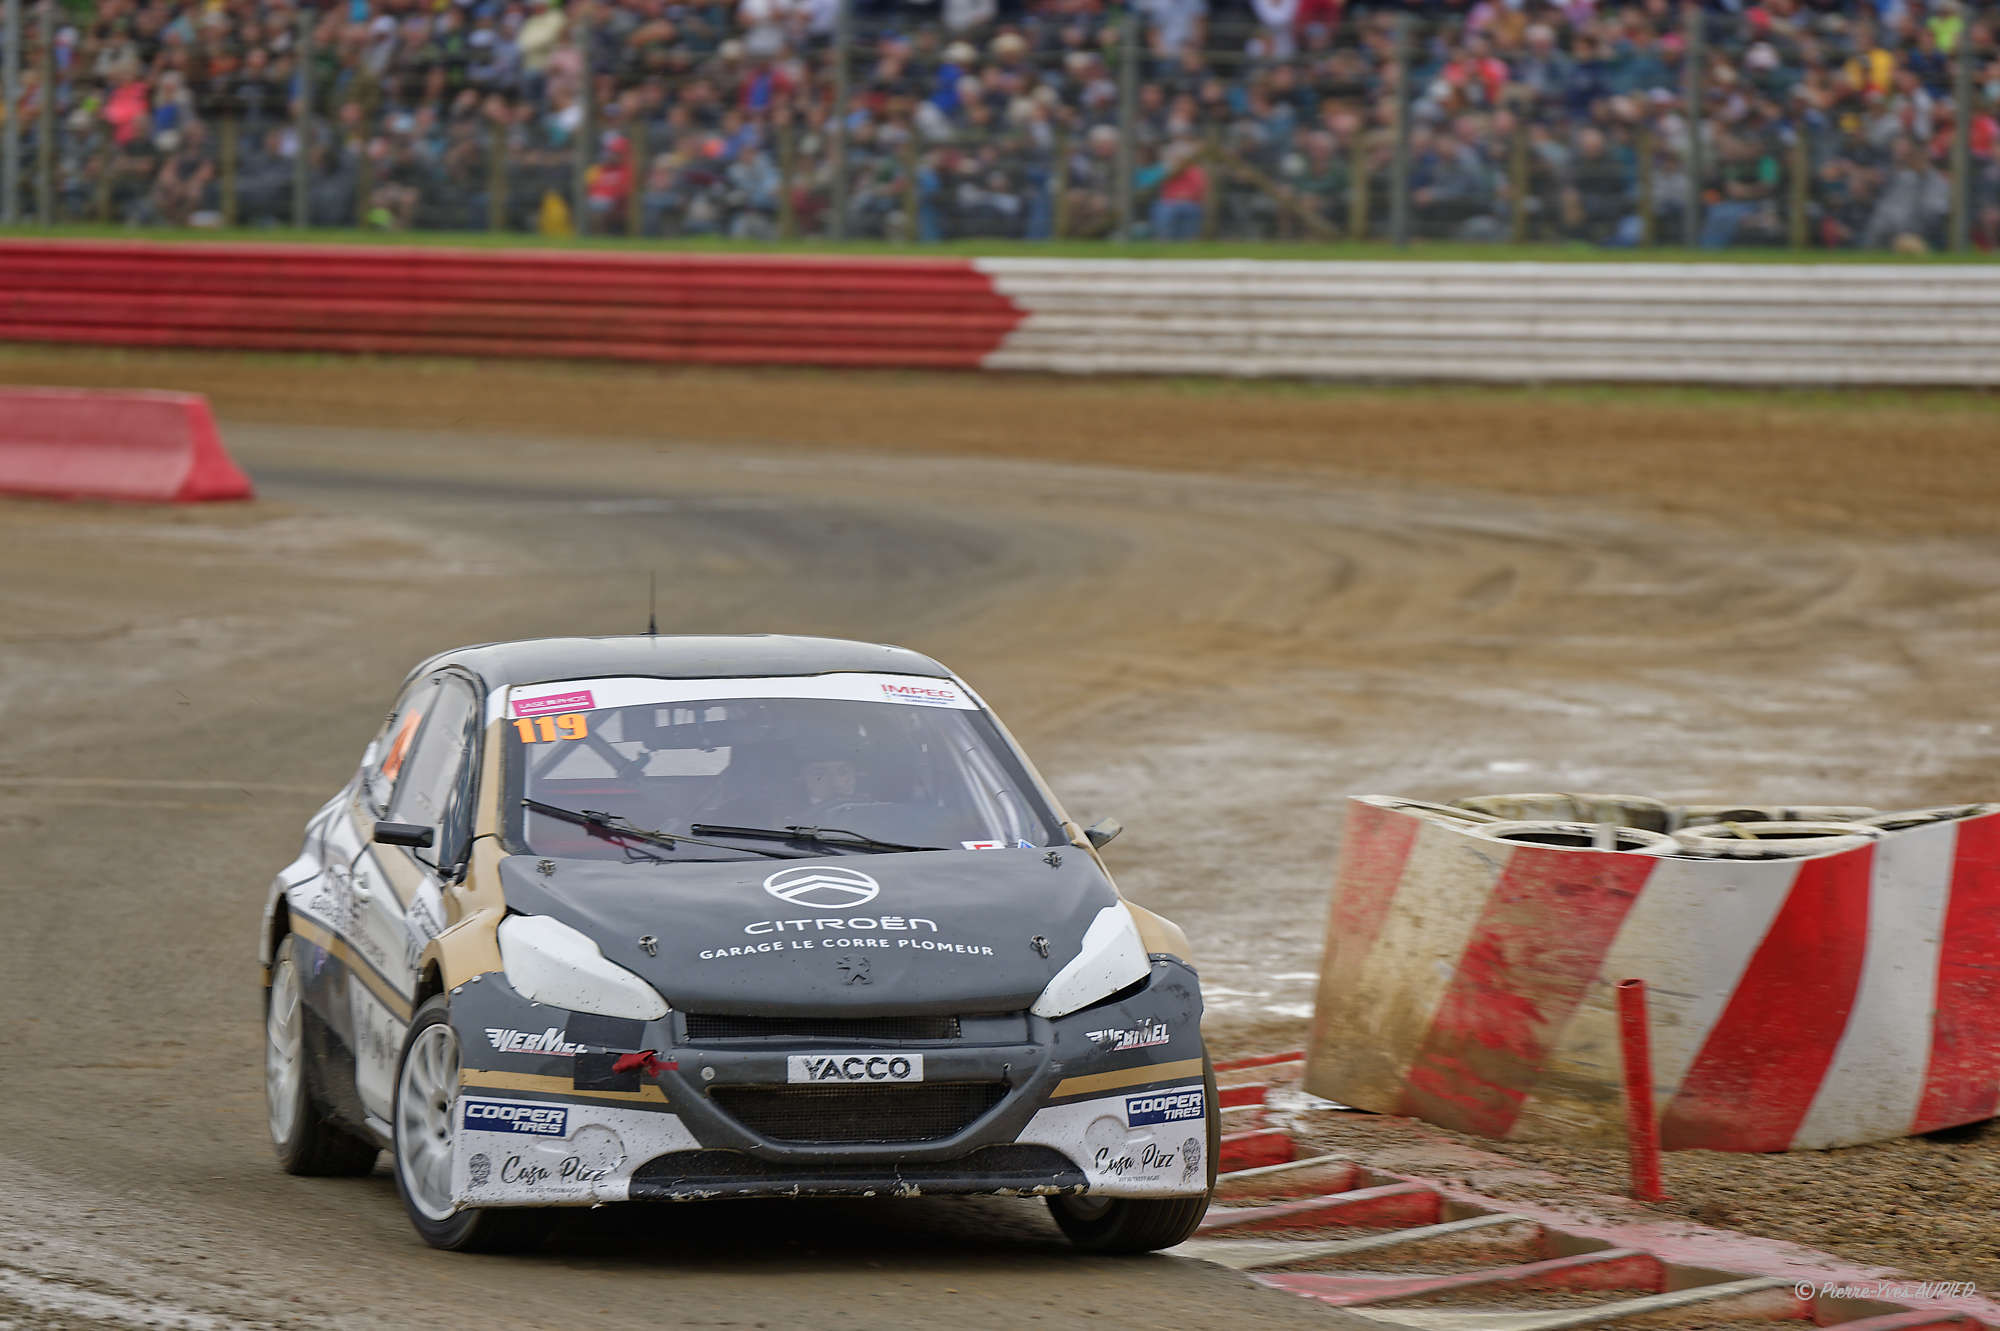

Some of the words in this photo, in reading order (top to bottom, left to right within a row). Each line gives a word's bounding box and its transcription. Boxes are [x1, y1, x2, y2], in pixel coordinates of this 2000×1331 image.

[881, 684, 955, 699] IMPEC
[513, 714, 588, 743] 119
[744, 915, 938, 936] CITROËN
[700, 941, 784, 960] GARAGE
[792, 940, 814, 950] LE
[822, 938, 890, 949] CORRE
[898, 939, 994, 956] PLOMEUR
[803, 1057, 911, 1080] YACCO
[466, 1104, 566, 1124] COOPER
[1129, 1093, 1202, 1115] COOPER
[1164, 1106, 1202, 1121] TIRES
[511, 1121, 562, 1134] TIRES
[501, 1155, 552, 1186] Casa
[1095, 1147, 1136, 1176] Casa
